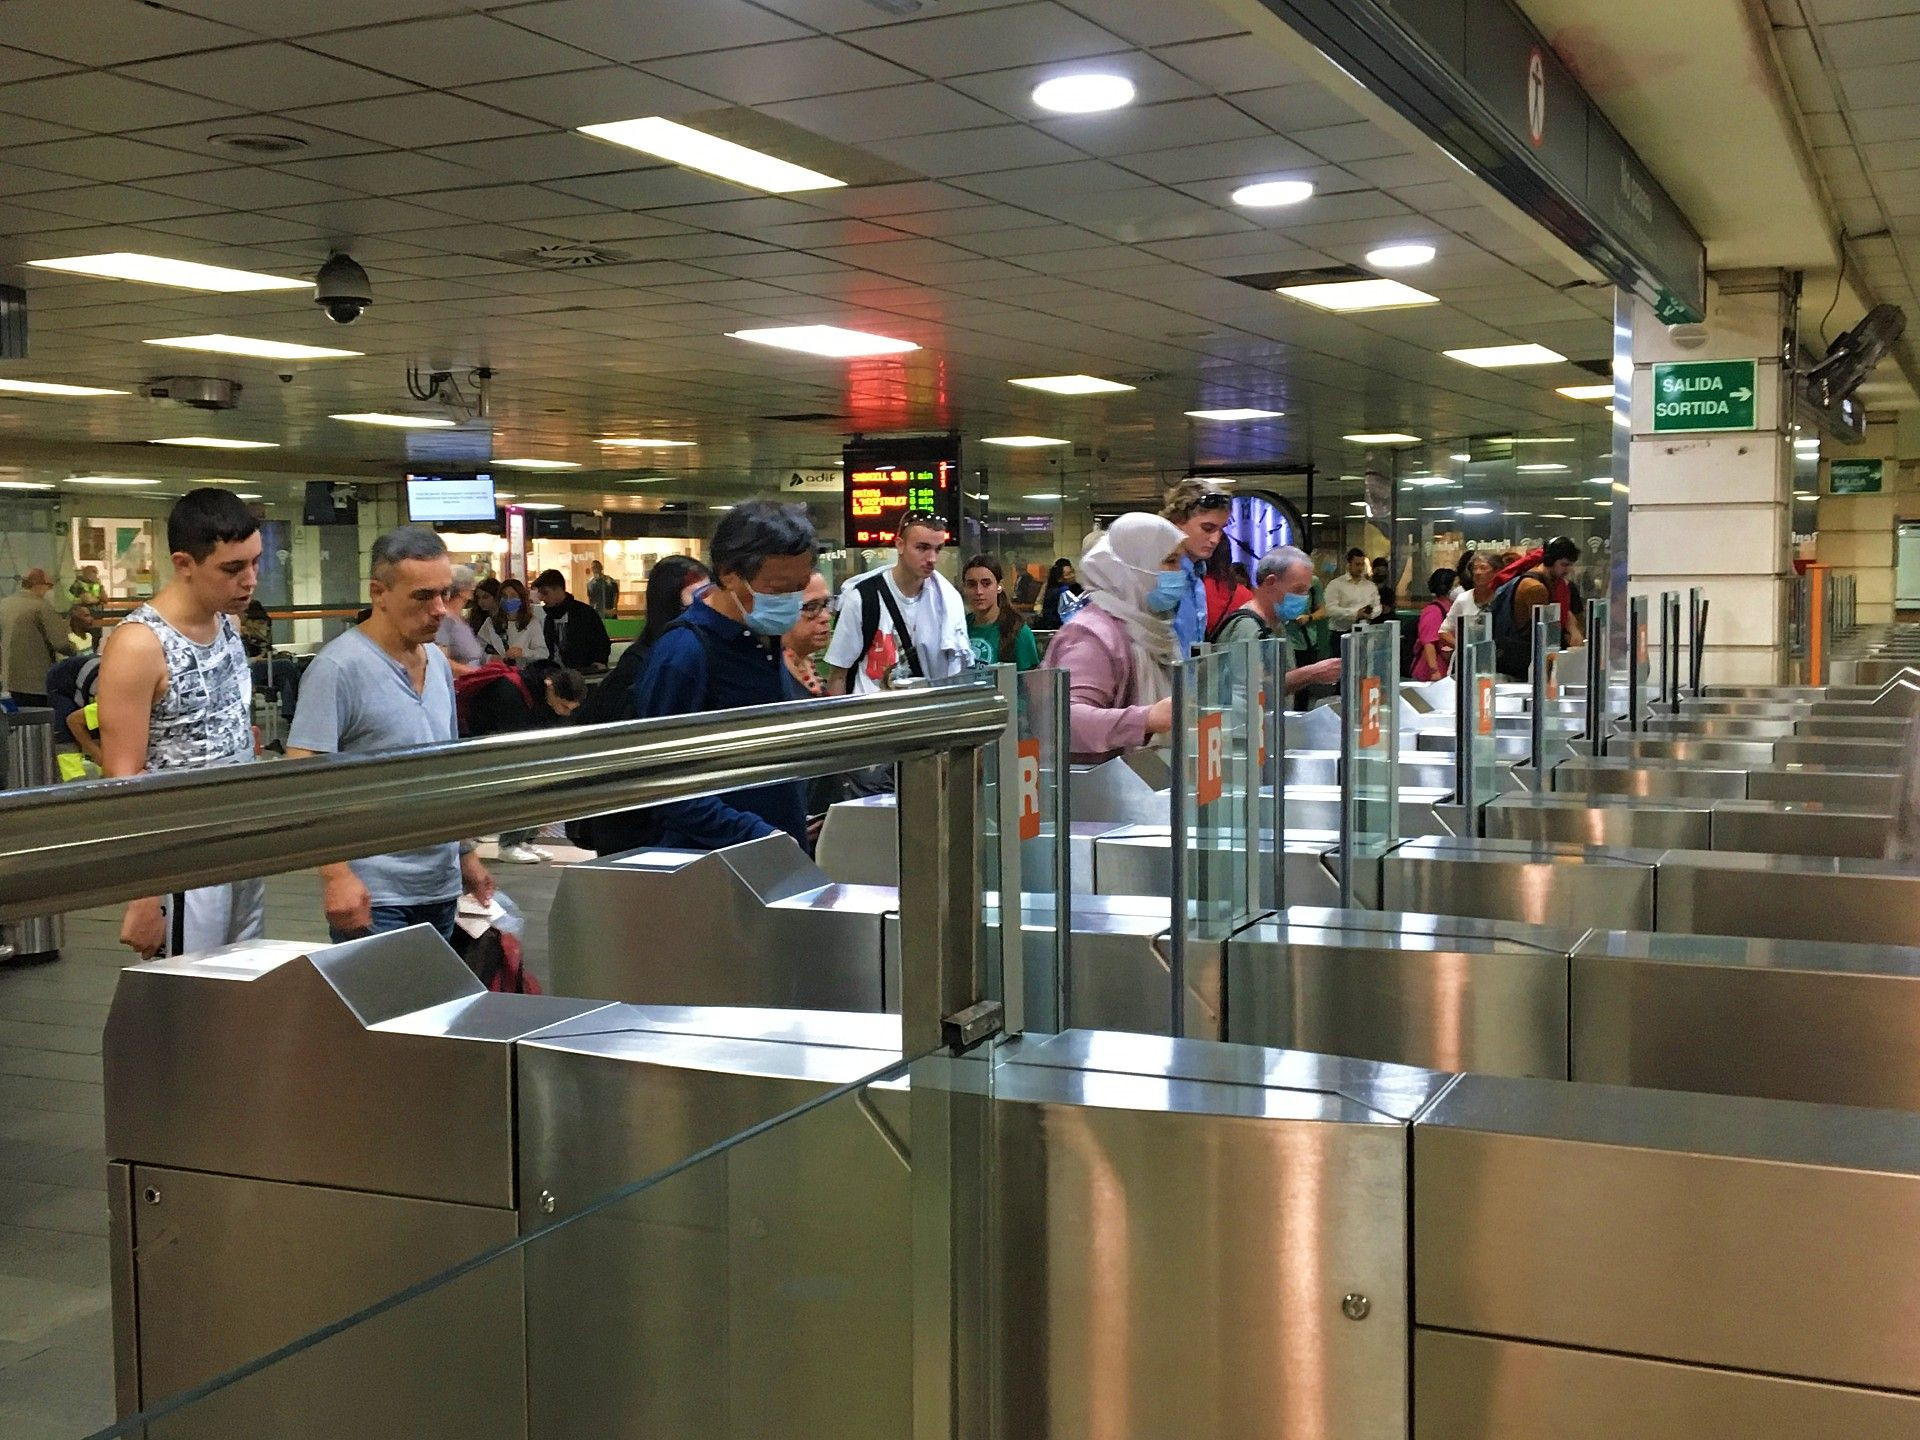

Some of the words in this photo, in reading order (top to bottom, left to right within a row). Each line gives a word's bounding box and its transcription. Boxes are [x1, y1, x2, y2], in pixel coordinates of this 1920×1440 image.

[1662, 376, 1723, 392] SALIDA
[1656, 401, 1729, 417] SORTIDA
[805, 472, 836, 482] adif
[910, 471, 915, 480] 1
[917, 471, 933, 480] min
[909, 488, 916, 496] 5
[917, 488, 934, 496] min
[1207, 726, 1221, 781] R
[1018, 755, 1039, 817] R
